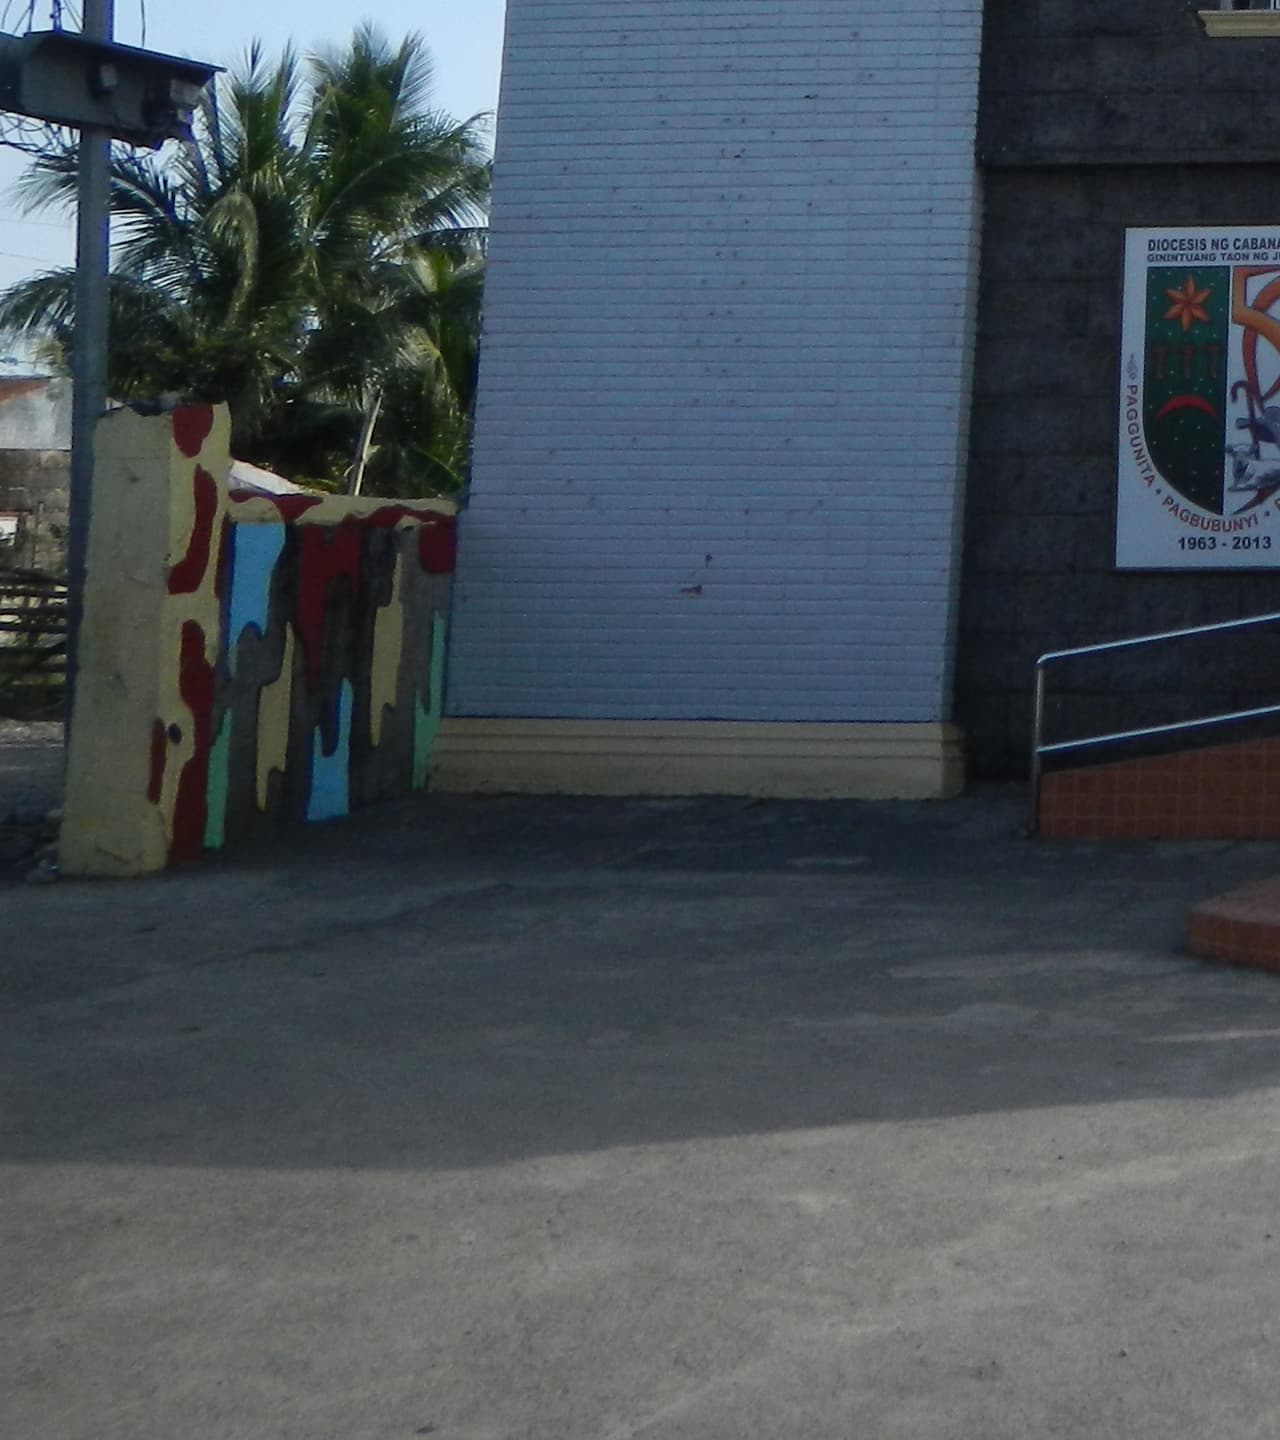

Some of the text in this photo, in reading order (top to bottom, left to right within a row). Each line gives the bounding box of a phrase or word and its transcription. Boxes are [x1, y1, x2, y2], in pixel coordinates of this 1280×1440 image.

[1148, 238, 1207, 252] DIOCESIS
[1211, 238, 1229, 251] NG
[1147, 251, 1217, 262] GININTUANG
[1220, 252, 1250, 261] TAON
[1252, 251, 1269, 261] NG
[1126, 384, 1156, 488] PAGGUNITA
[1161, 496, 1259, 533] PAGBUBUNYI
[1178, 536, 1217, 551] 1963
[1231, 536, 1272, 550] 2013
